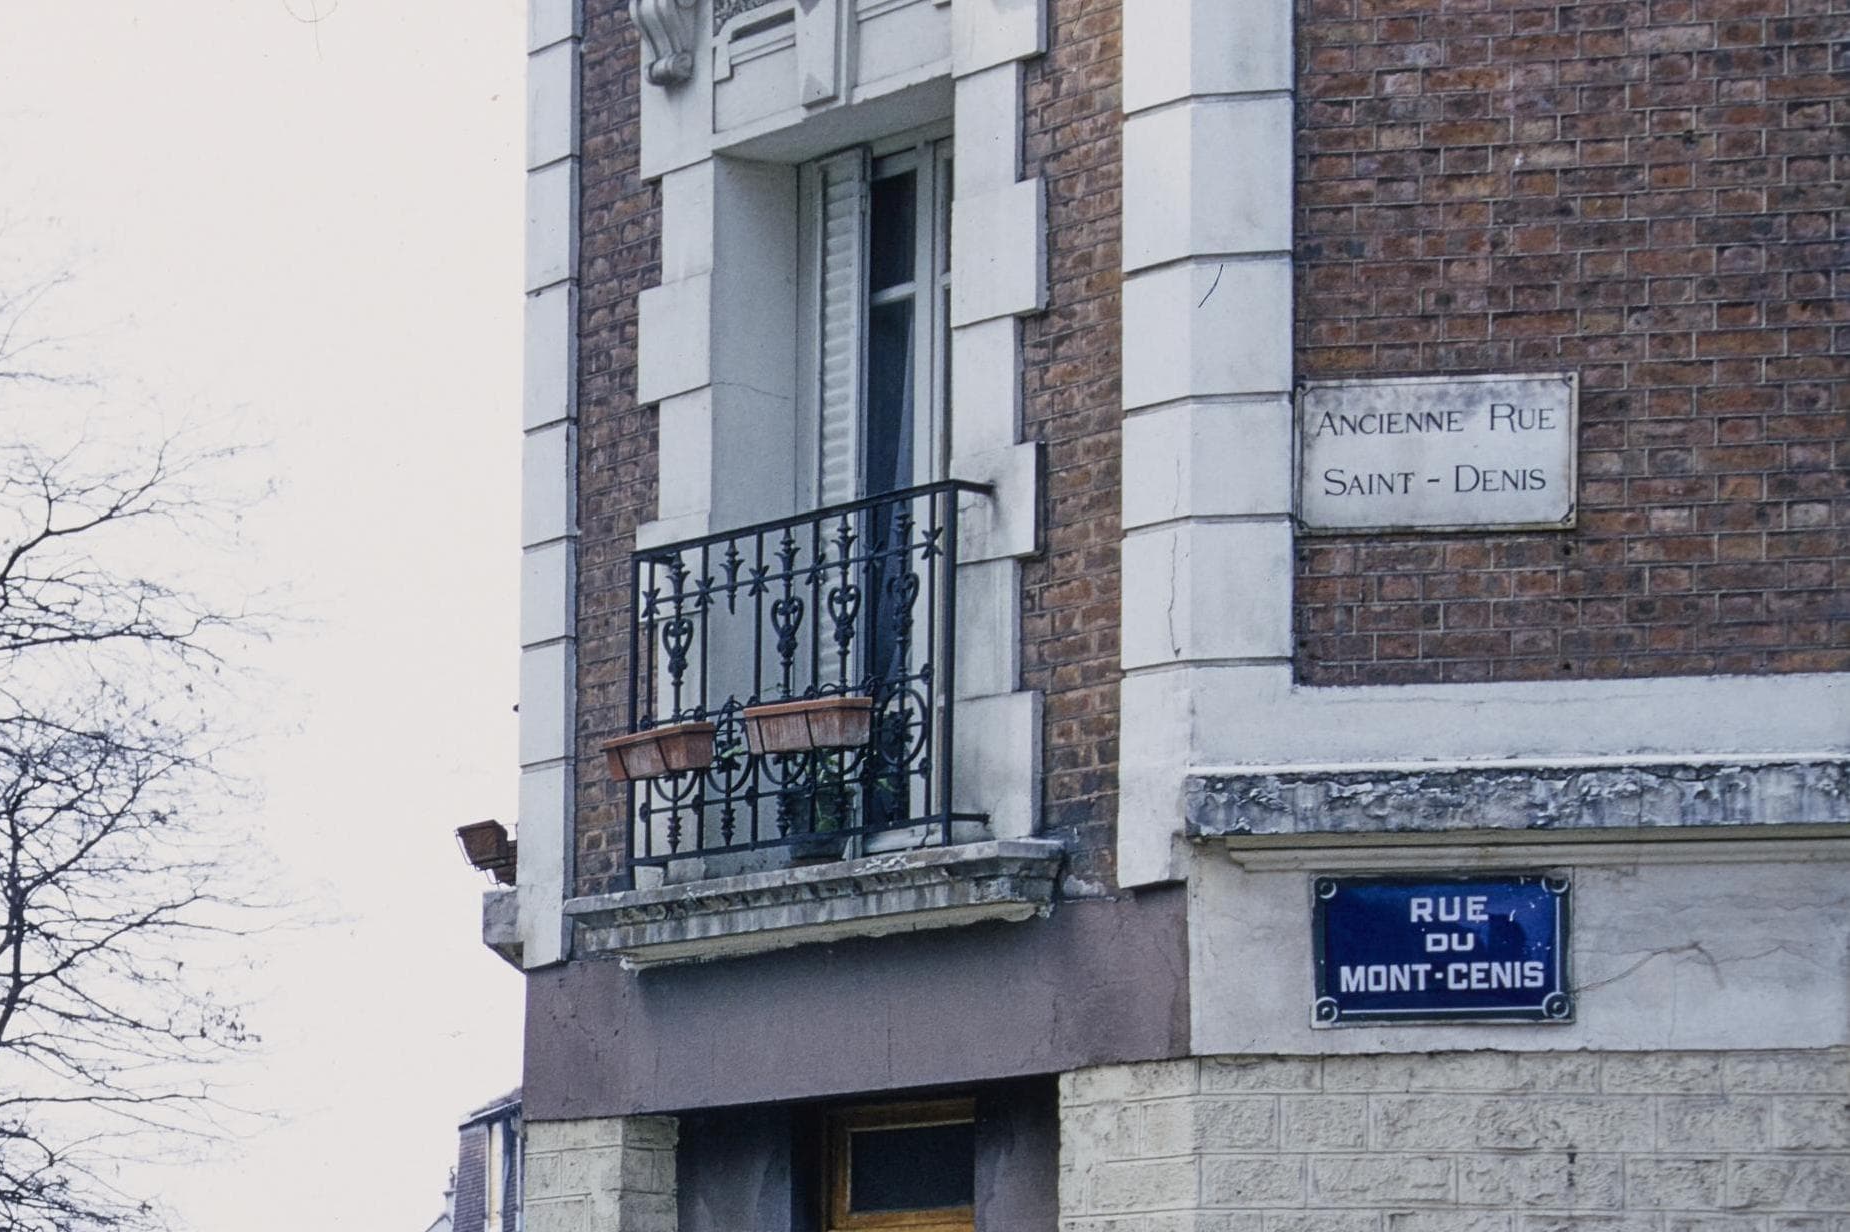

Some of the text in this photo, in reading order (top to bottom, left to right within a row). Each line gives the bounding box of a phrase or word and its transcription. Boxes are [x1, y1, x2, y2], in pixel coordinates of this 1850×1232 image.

[1316, 402, 1557, 437] ANCIENNE RUE
[1409, 895, 1489, 923] RUE
[1425, 932, 1475, 952] DU
[1339, 960, 1545, 993] MONT-CENIS
